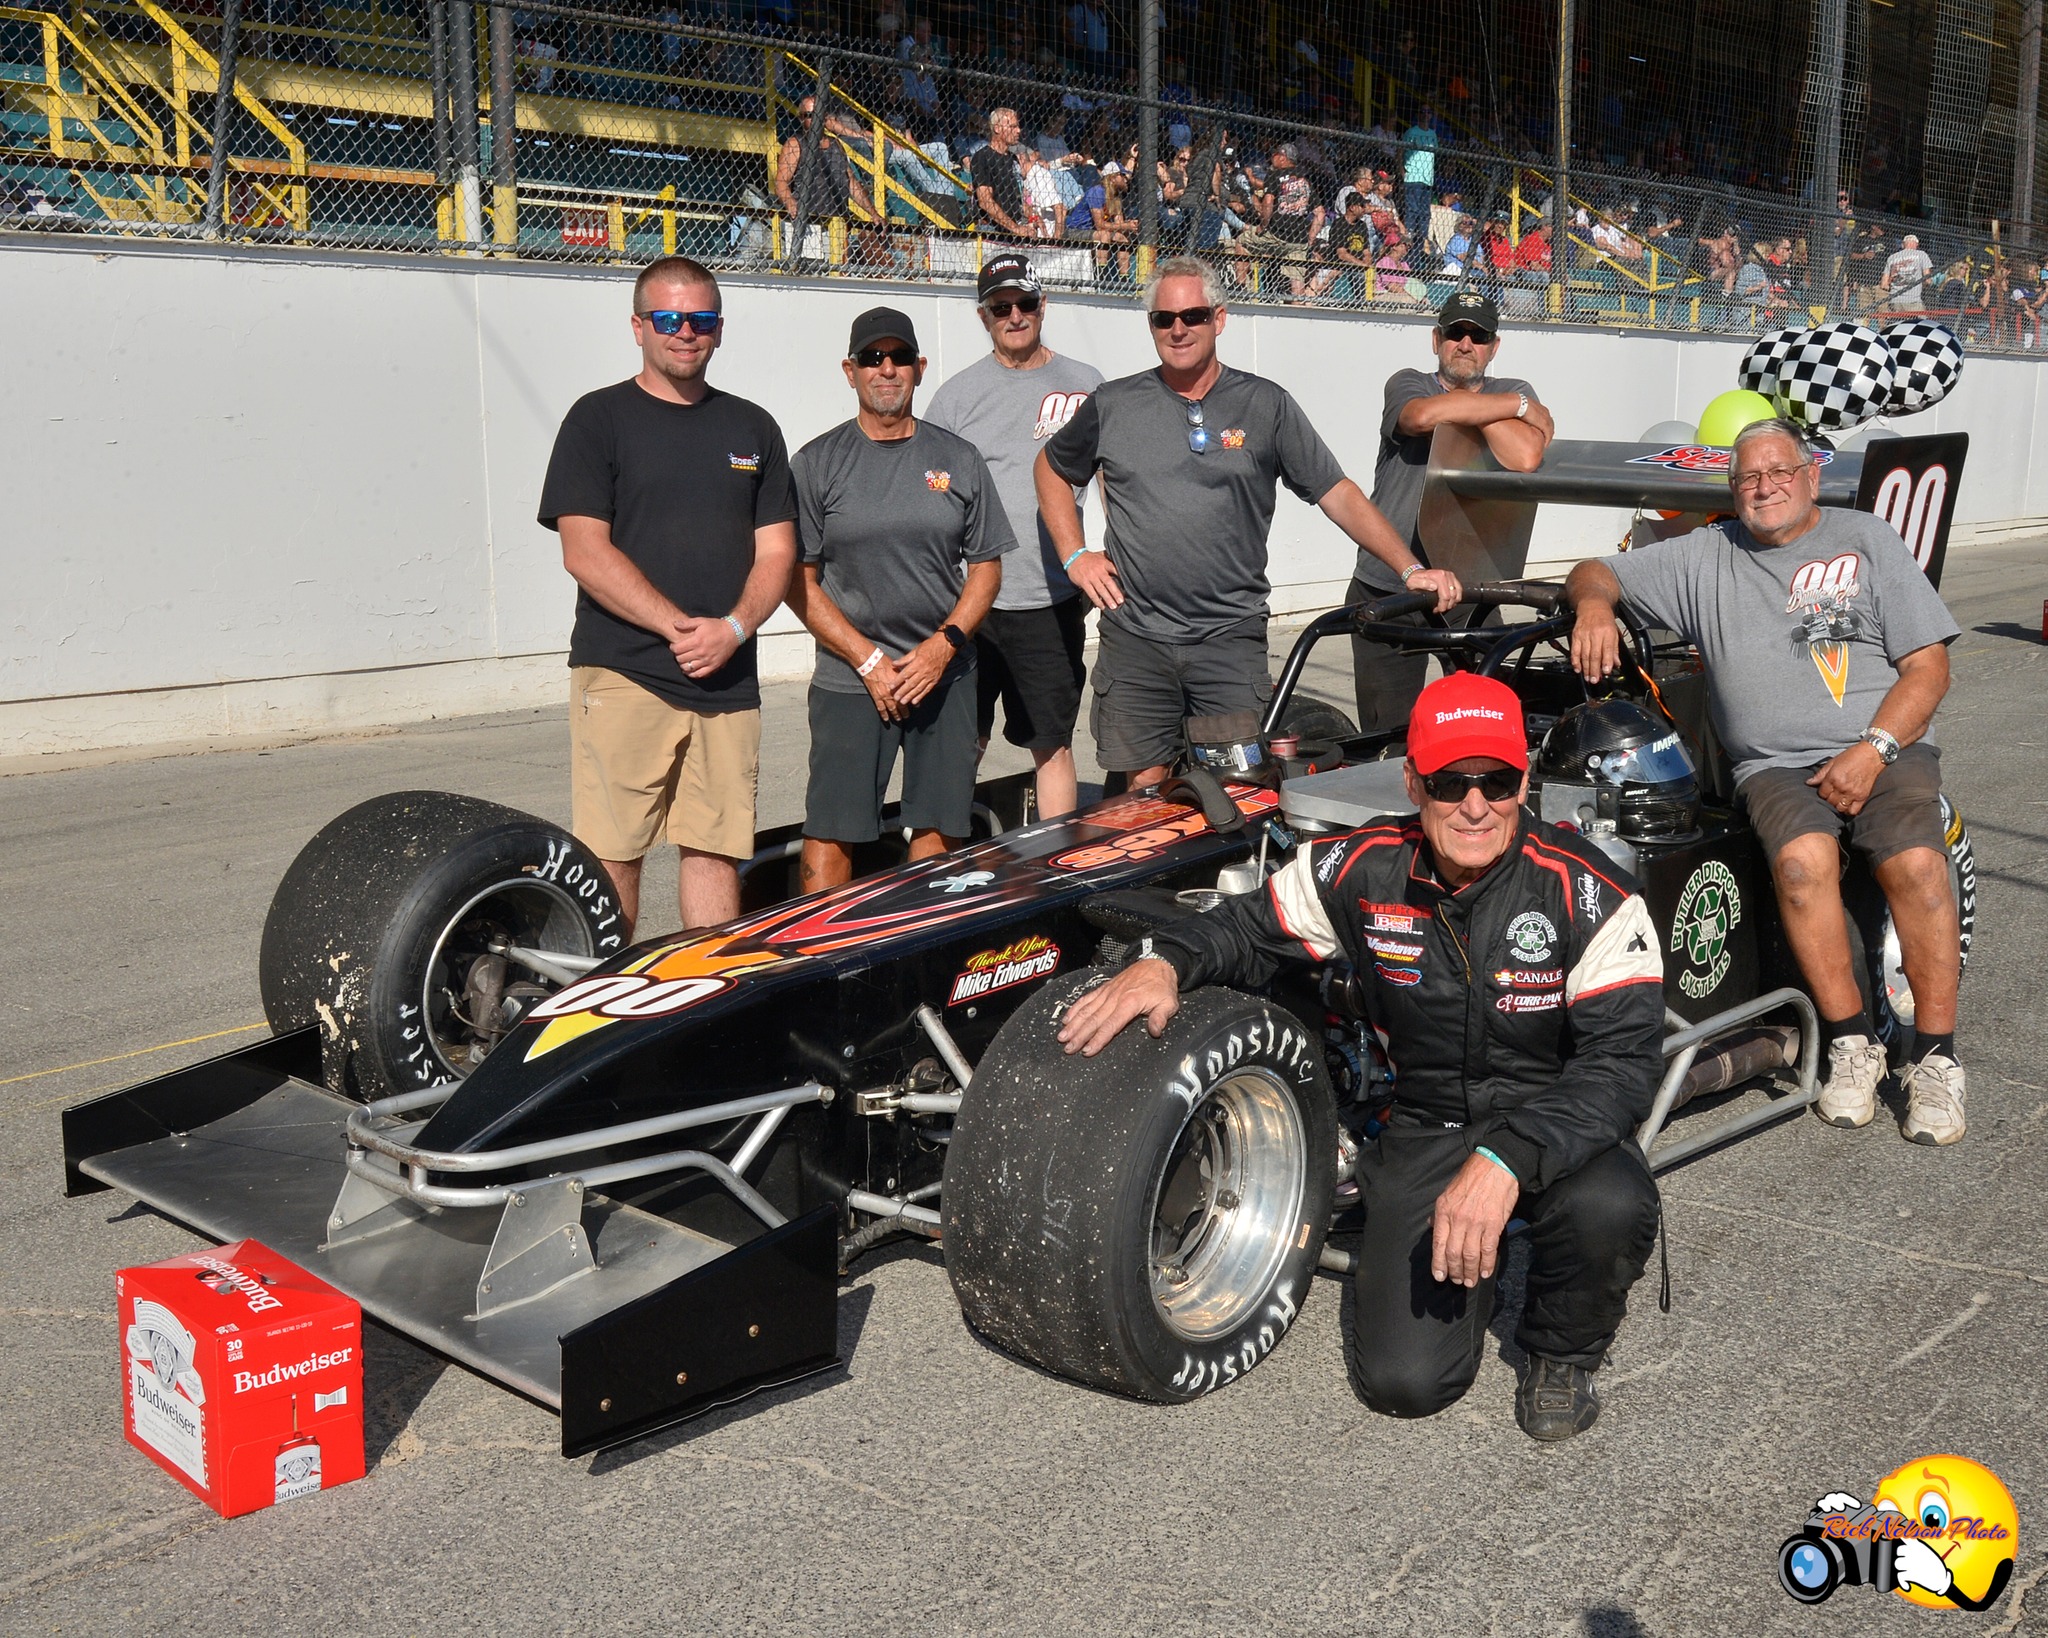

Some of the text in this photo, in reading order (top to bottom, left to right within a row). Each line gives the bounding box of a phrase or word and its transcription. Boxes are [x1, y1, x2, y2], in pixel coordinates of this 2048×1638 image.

[563, 211, 606, 239] EXIT
[1435, 705, 1505, 725] Budweiser
[532, 839, 622, 952] Hoosie
[1671, 860, 1742, 953] BUTLER DISPOSAL
[1377, 916, 1411, 930] Best
[1506, 911, 1558, 943] BUTLER DISPOSAL
[966, 935, 1049, 973] Thank You
[1376, 950, 1415, 962] COLLISION
[1510, 947, 1552, 963] SYSTEMS
[952, 947, 1059, 1002] Mike Edwards
[1515, 969, 1563, 984] CANALE
[1679, 949, 1731, 999] SYSTEMS
[526, 975, 732, 1018] 00
[188, 1255, 284, 1314] Budweiser
[226, 1338, 243, 1352] 30
[233, 1347, 353, 1394] Budweiser
[136, 1373, 197, 1438] Budweiser
